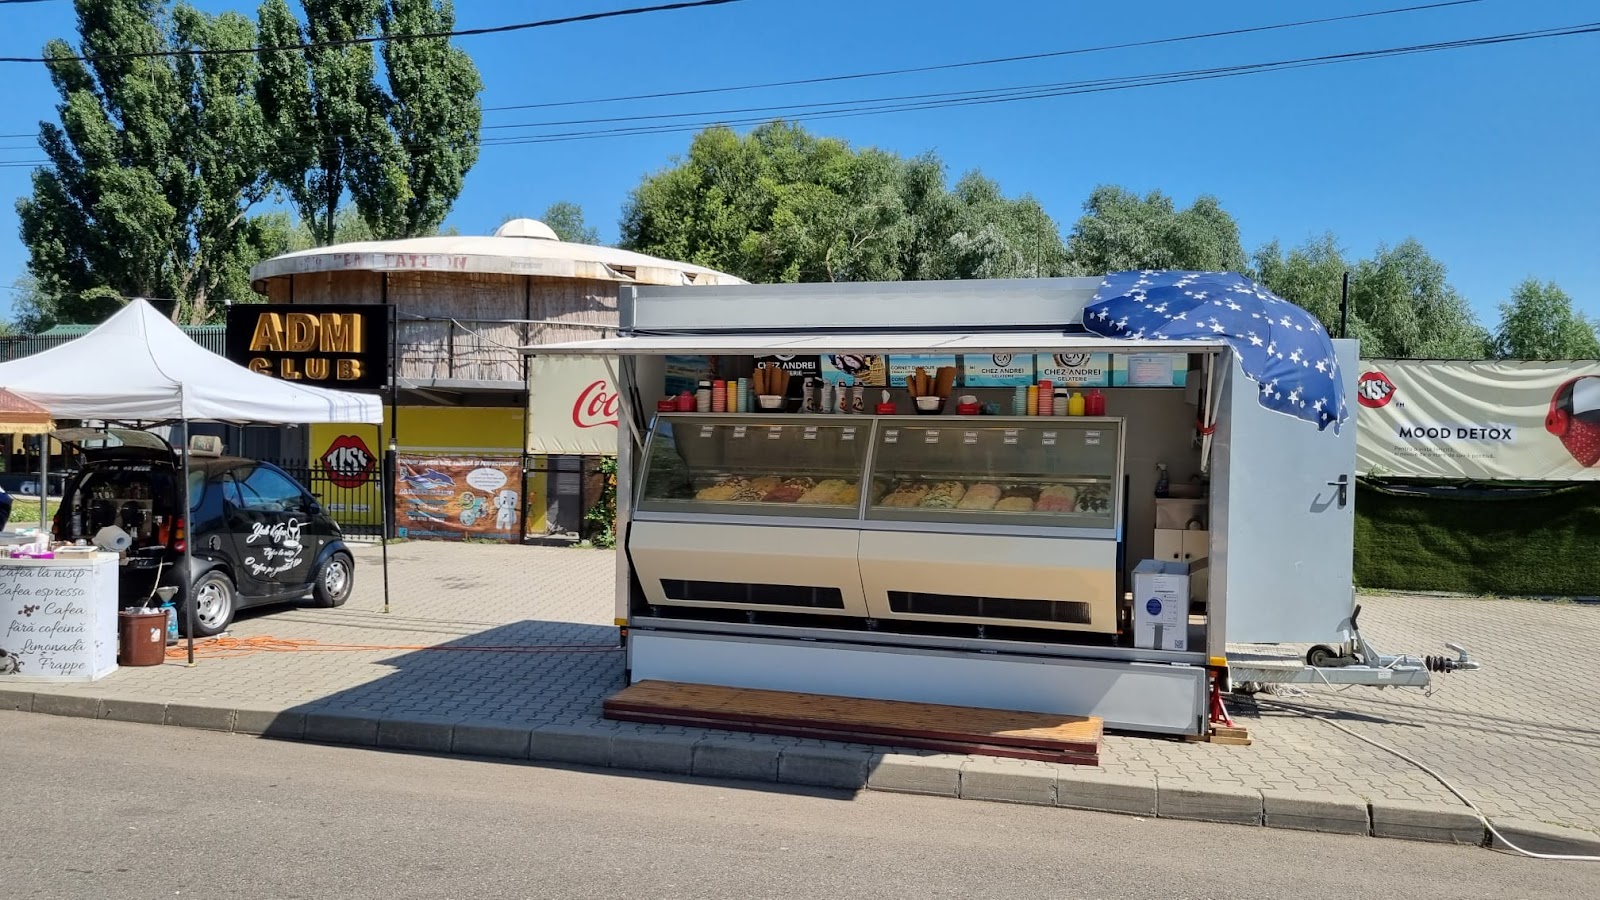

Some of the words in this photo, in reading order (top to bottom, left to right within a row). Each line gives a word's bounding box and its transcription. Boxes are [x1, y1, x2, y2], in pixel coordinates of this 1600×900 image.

[249, 312, 361, 352] ADM
[249, 357, 361, 380] CLUB
[758, 361, 781, 370] CHZ
[782, 361, 815, 370] ANDREI
[1399, 426, 1451, 440] MOOD
[1456, 427, 1512, 441] DETOX
[0, 565, 34, 582] Cafea
[37, 566, 52, 578] la
[53, 568, 85, 583] nisip
[0, 583, 31, 601] Cafea
[35, 587, 85, 602] espresso
[44, 602, 85, 620] Cafea
[7, 619, 37, 638] fără
[38, 620, 85, 639] cofeină
[20, 639, 85, 655] Limonadă
[39, 657, 86, 675] Frappe
